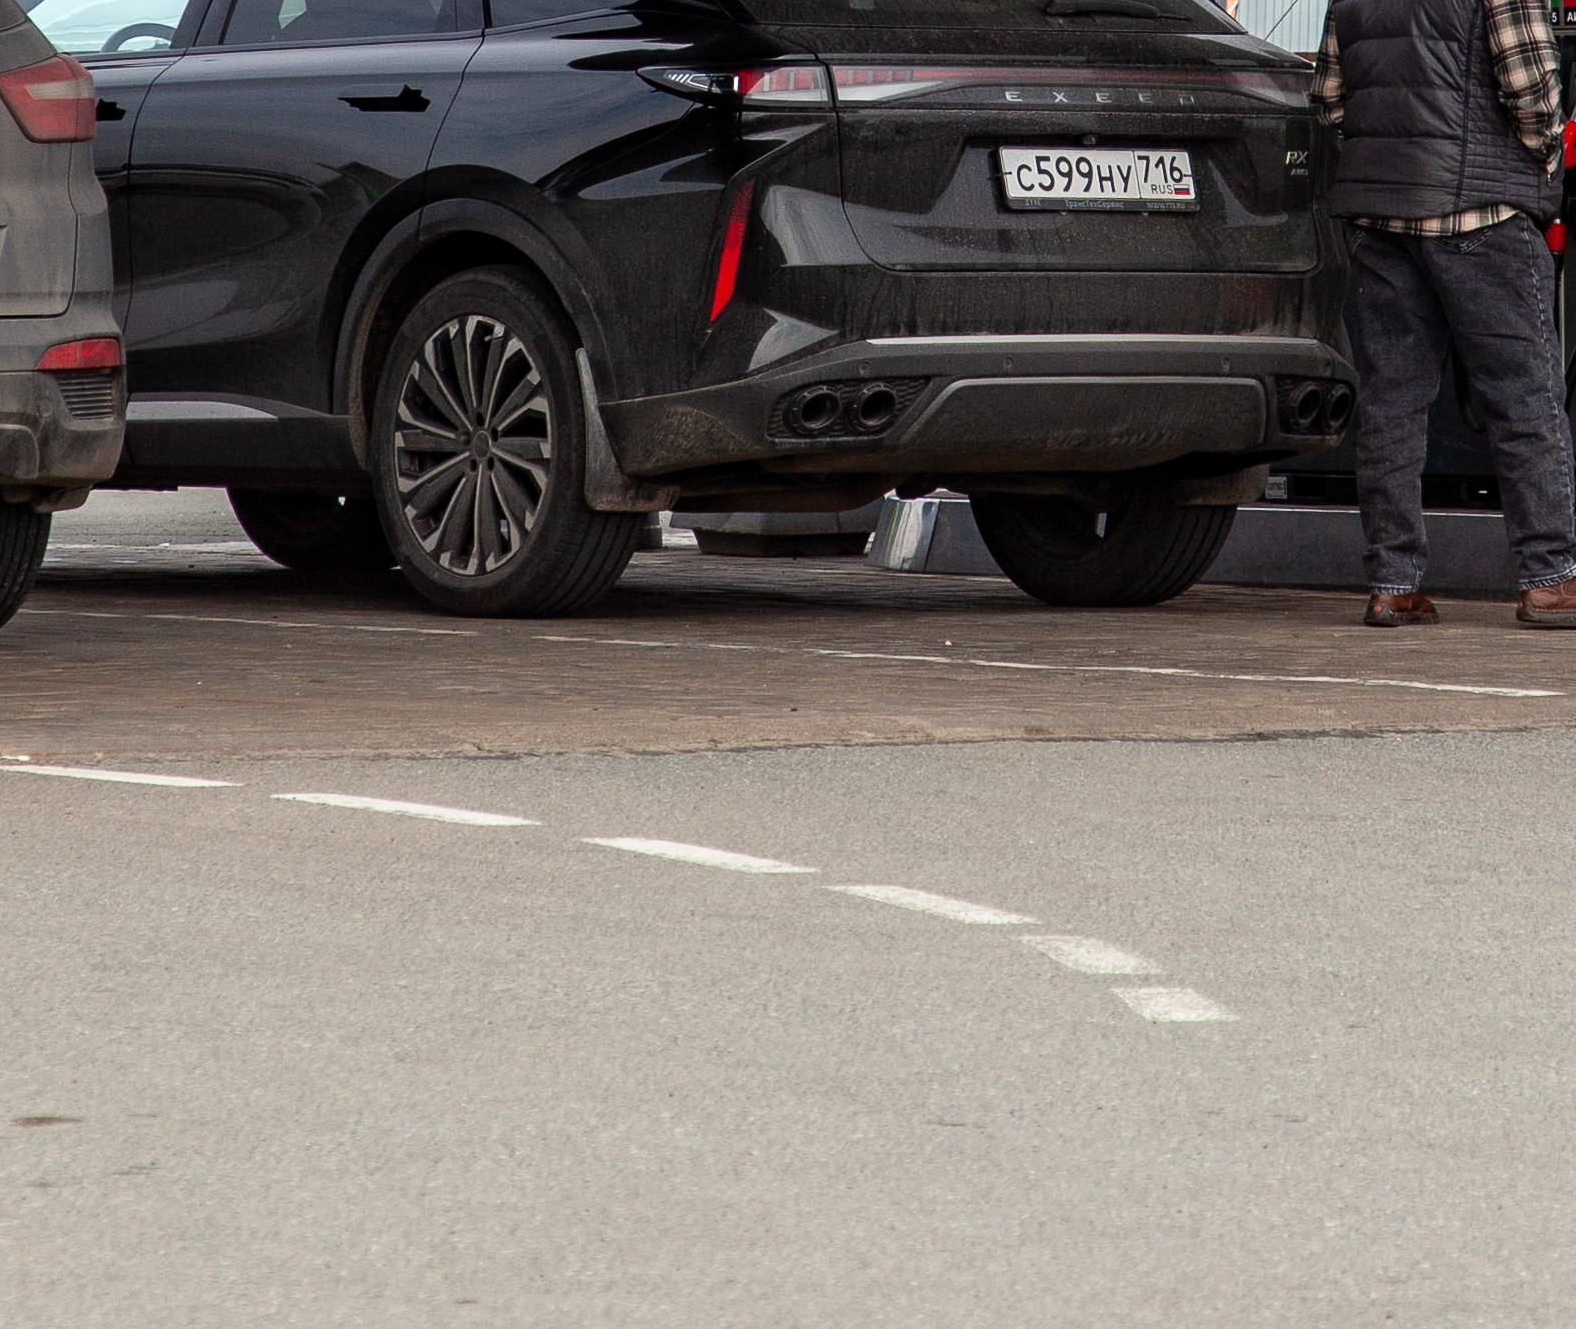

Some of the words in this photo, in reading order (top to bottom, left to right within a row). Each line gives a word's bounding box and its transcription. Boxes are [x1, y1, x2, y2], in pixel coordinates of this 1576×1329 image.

[1286, 151, 1308, 164] RX
[1016, 155, 1132, 193] С599НУ
[1136, 155, 1184, 184] 716
[1151, 184, 1173, 195] RUS
